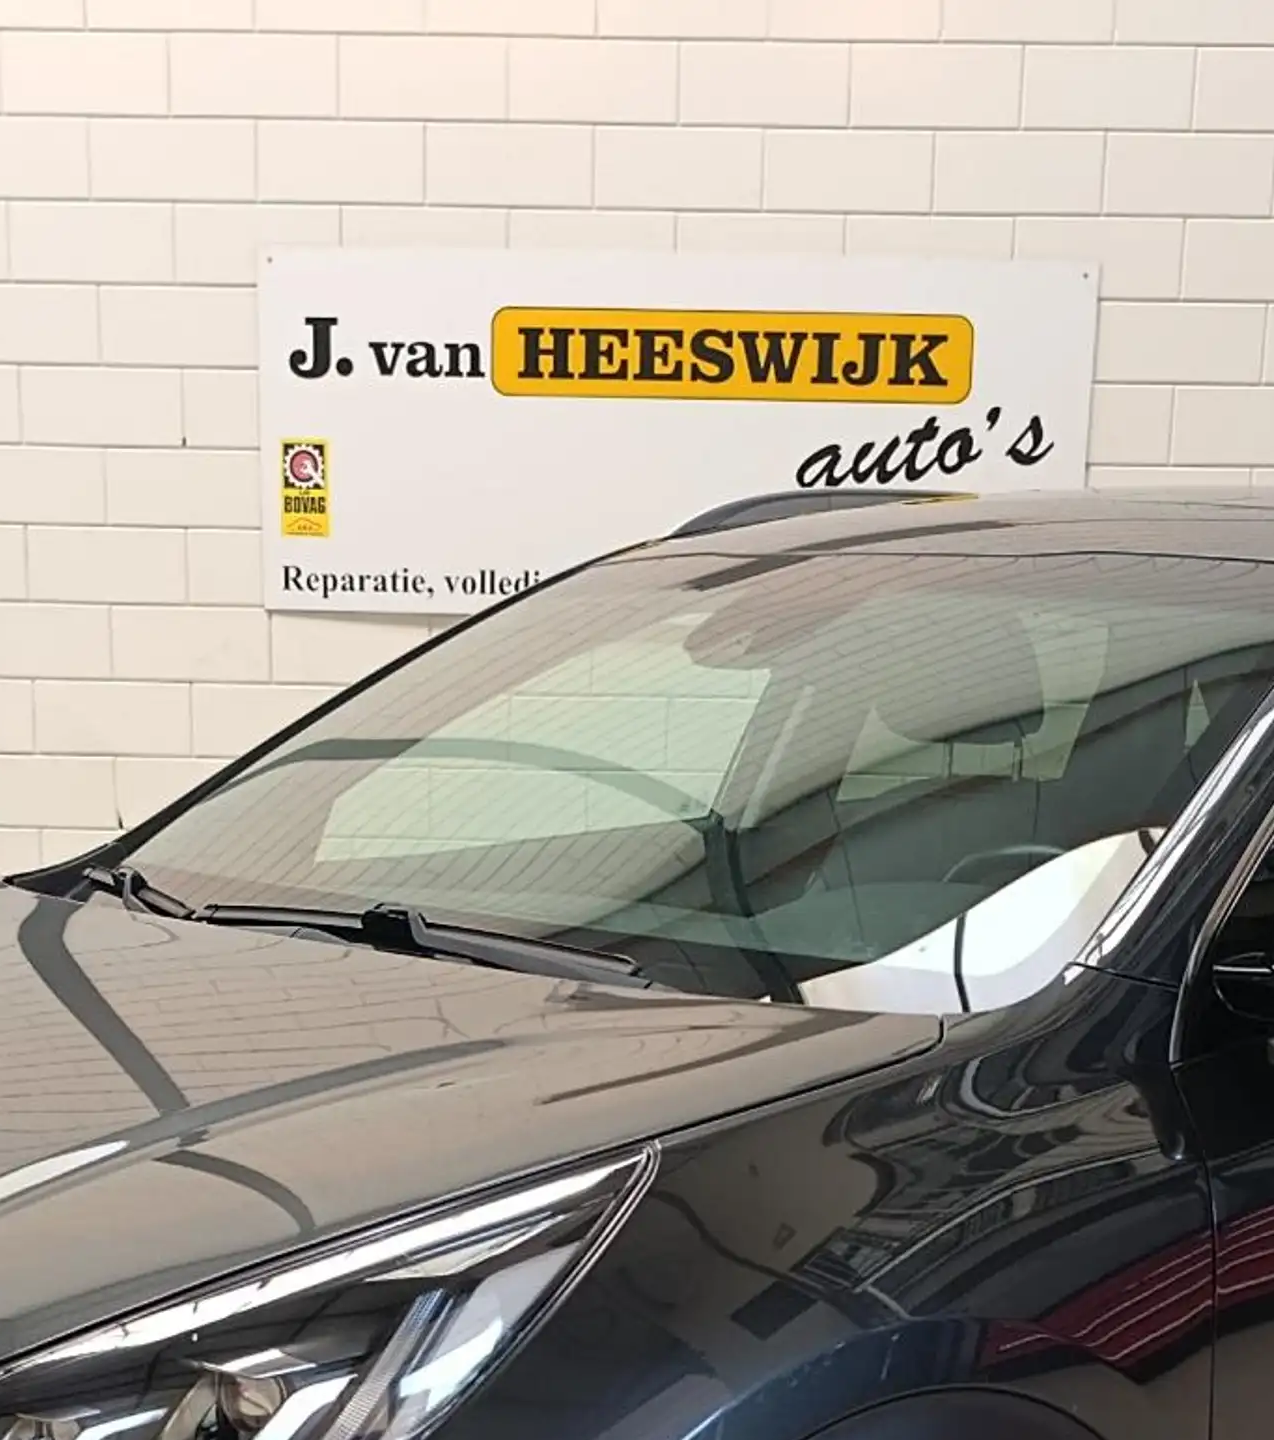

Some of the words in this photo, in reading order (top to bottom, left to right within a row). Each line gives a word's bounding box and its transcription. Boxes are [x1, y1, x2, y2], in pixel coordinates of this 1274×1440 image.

[288, 316, 354, 379] J.
[369, 341, 486, 379] van
[516, 327, 949, 387] HEESWIJK
[796, 406, 1054, 487] auto's
[283, 495, 326, 514] BOVAG
[282, 565, 434, 598] Reparatie,
